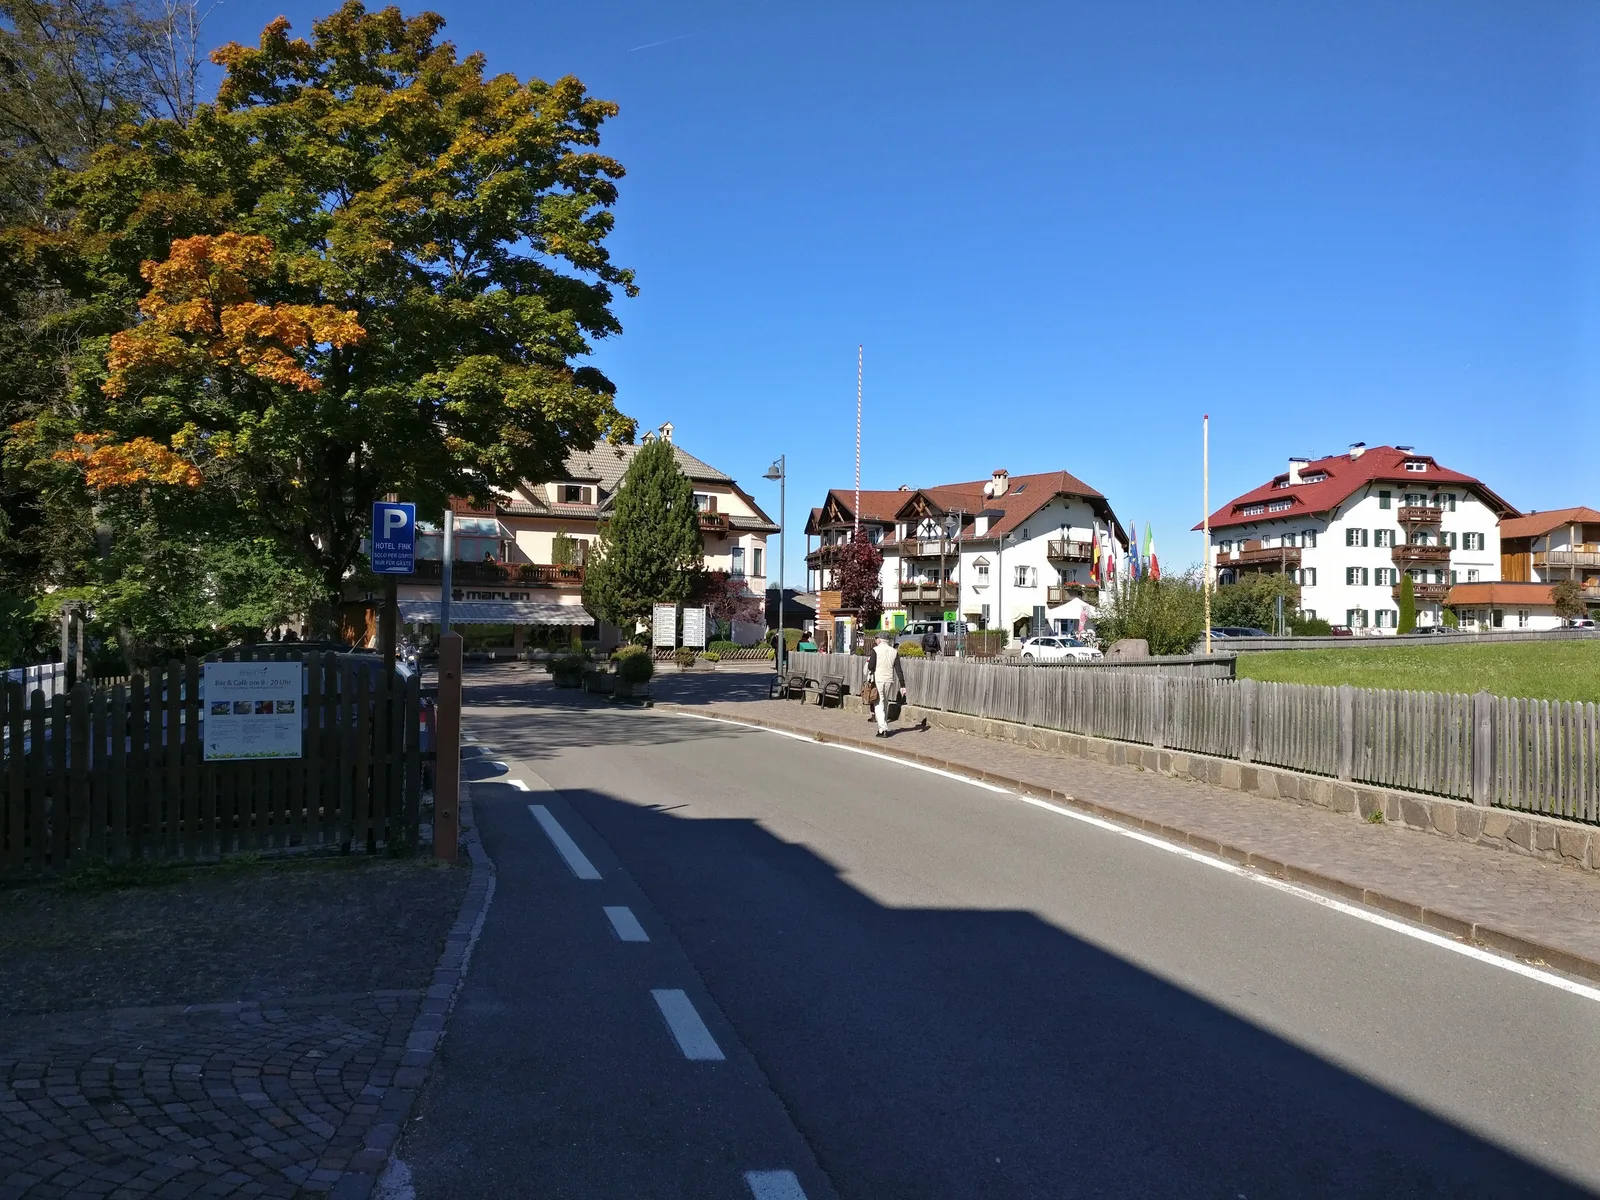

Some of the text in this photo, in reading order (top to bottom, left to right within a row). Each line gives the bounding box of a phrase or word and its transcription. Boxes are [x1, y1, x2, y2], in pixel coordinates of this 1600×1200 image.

[383, 508, 408, 539] P
[375, 542, 412, 550] HOTEL FINK
